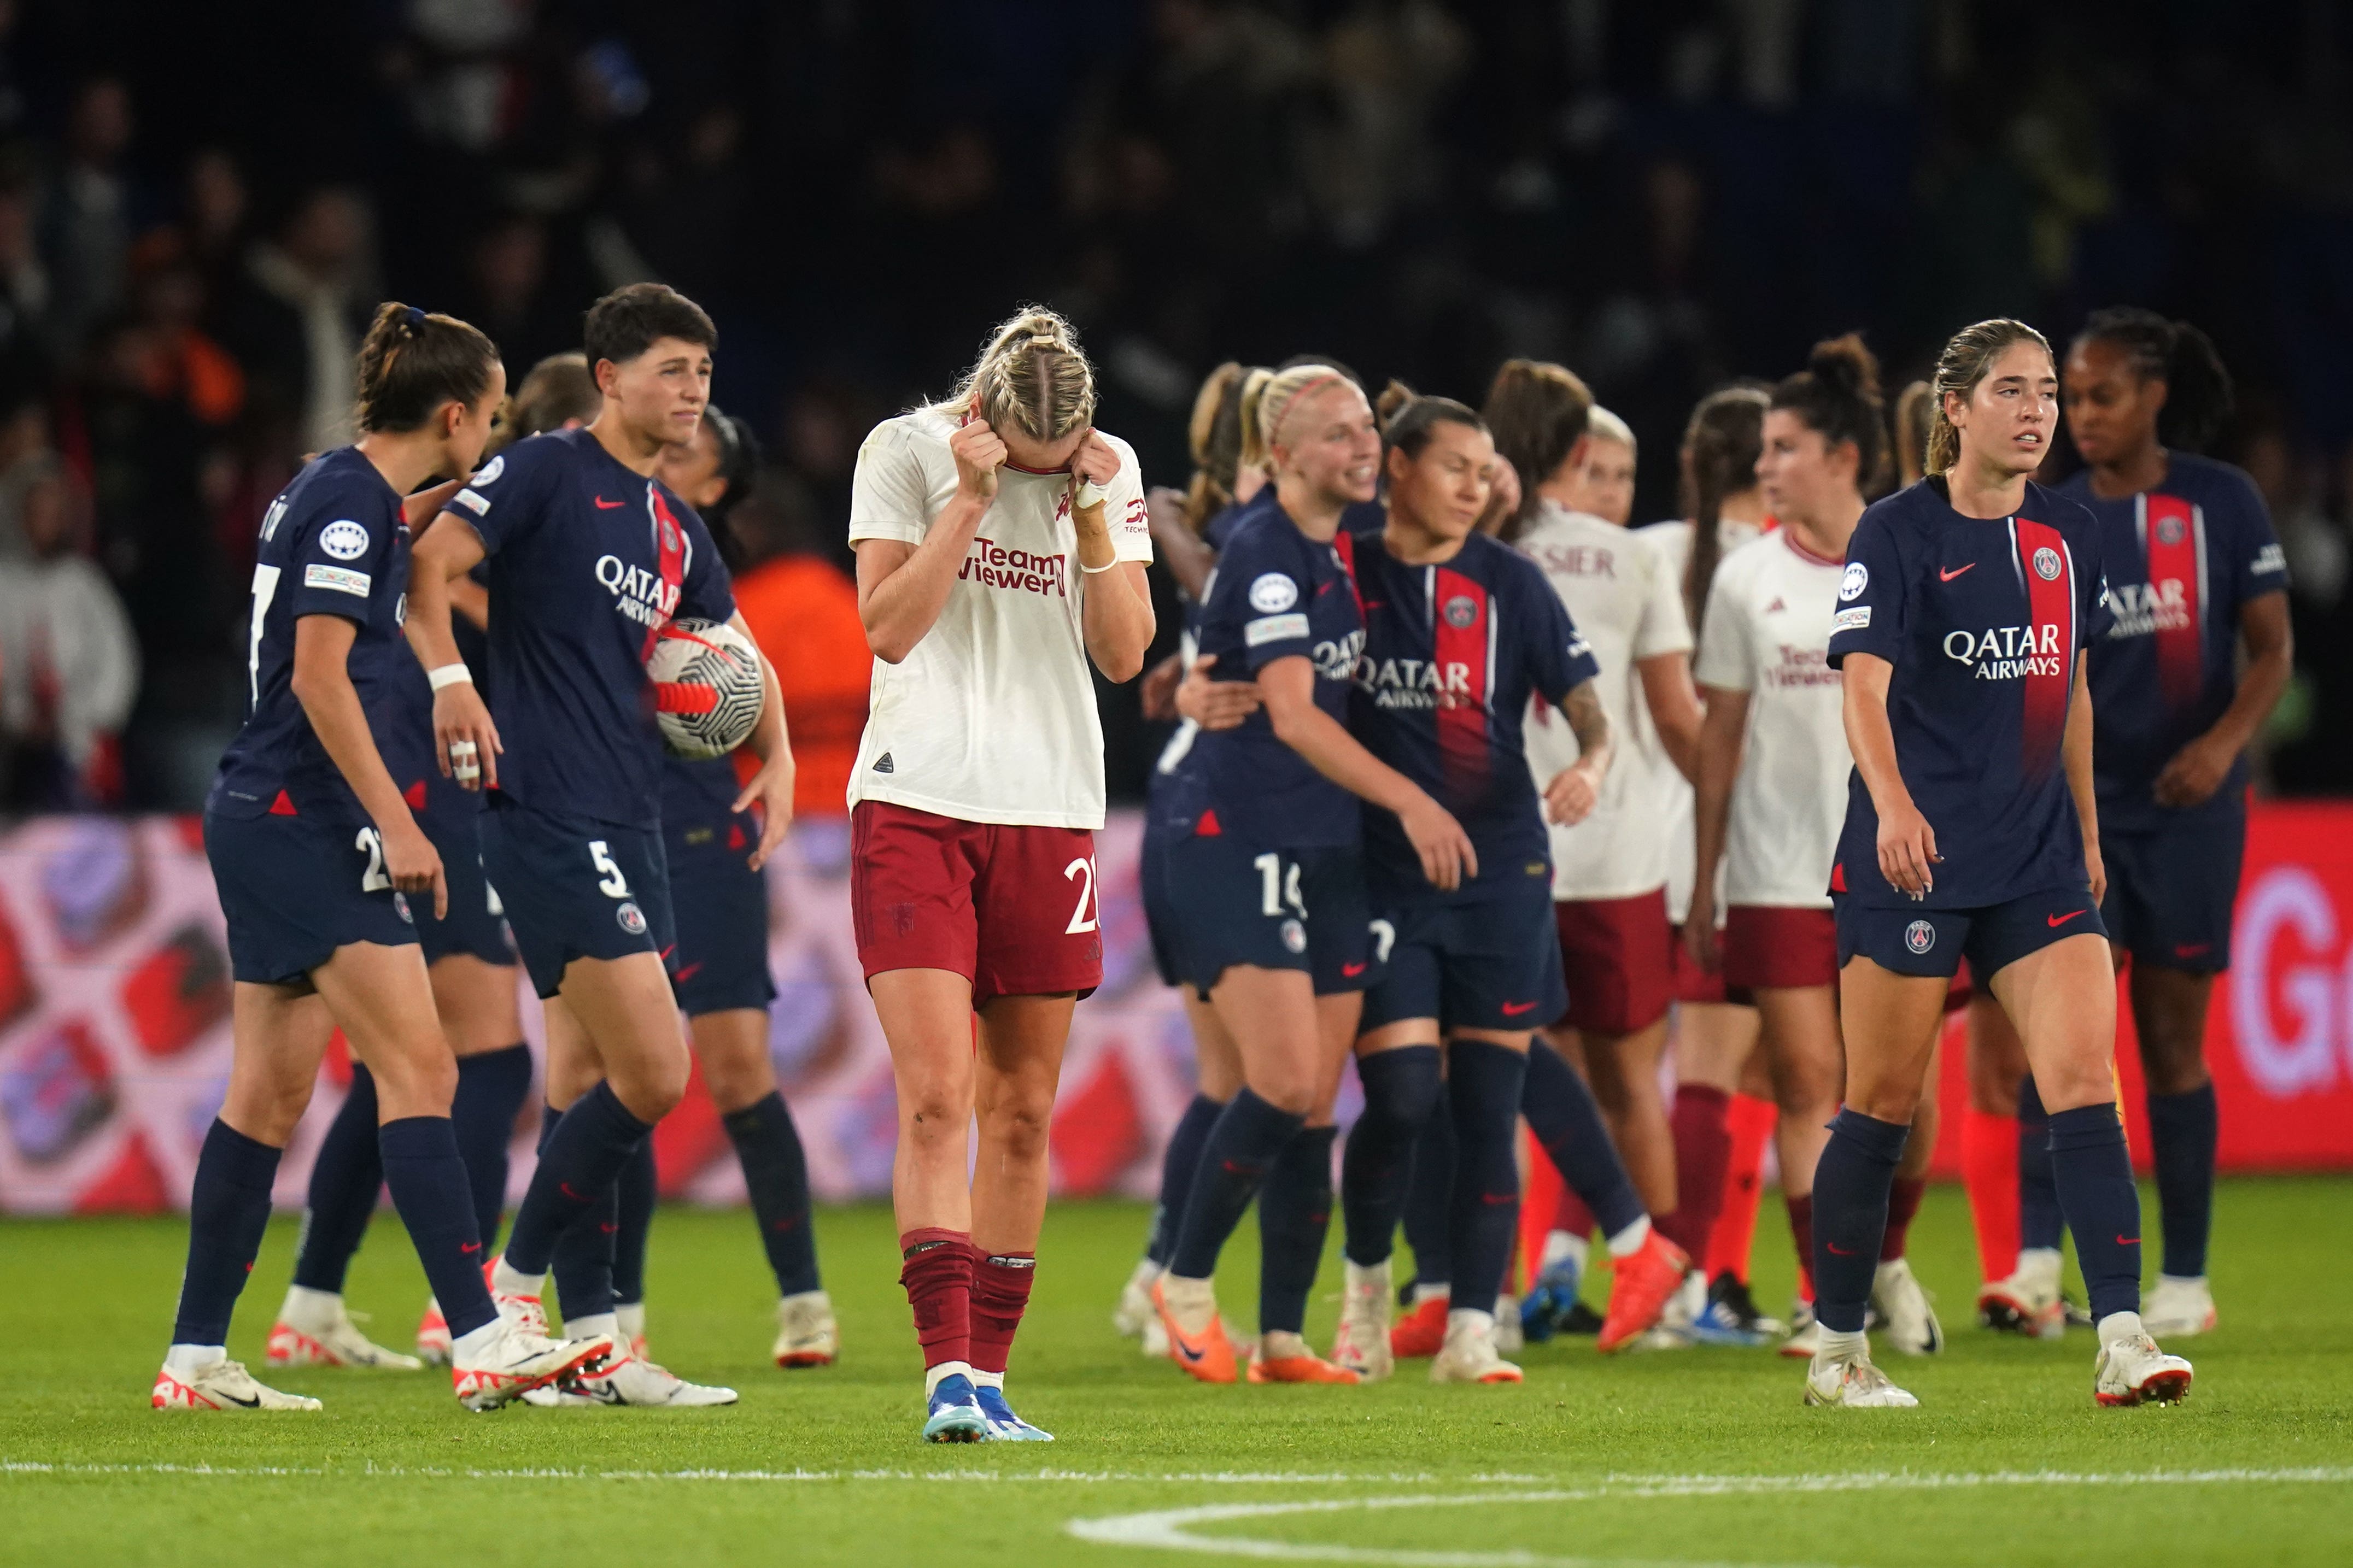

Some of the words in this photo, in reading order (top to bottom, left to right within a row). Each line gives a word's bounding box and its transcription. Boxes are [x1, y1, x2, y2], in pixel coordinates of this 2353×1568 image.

[958, 556, 1055, 597] Viewer
[974, 537, 1054, 575] Team
[1944, 624, 2060, 666] QATAR
[1975, 656, 2061, 680] AIRWAYS
[355, 826, 390, 892] 2
[588, 840, 631, 898] 5
[2229, 864, 2353, 1097] G
